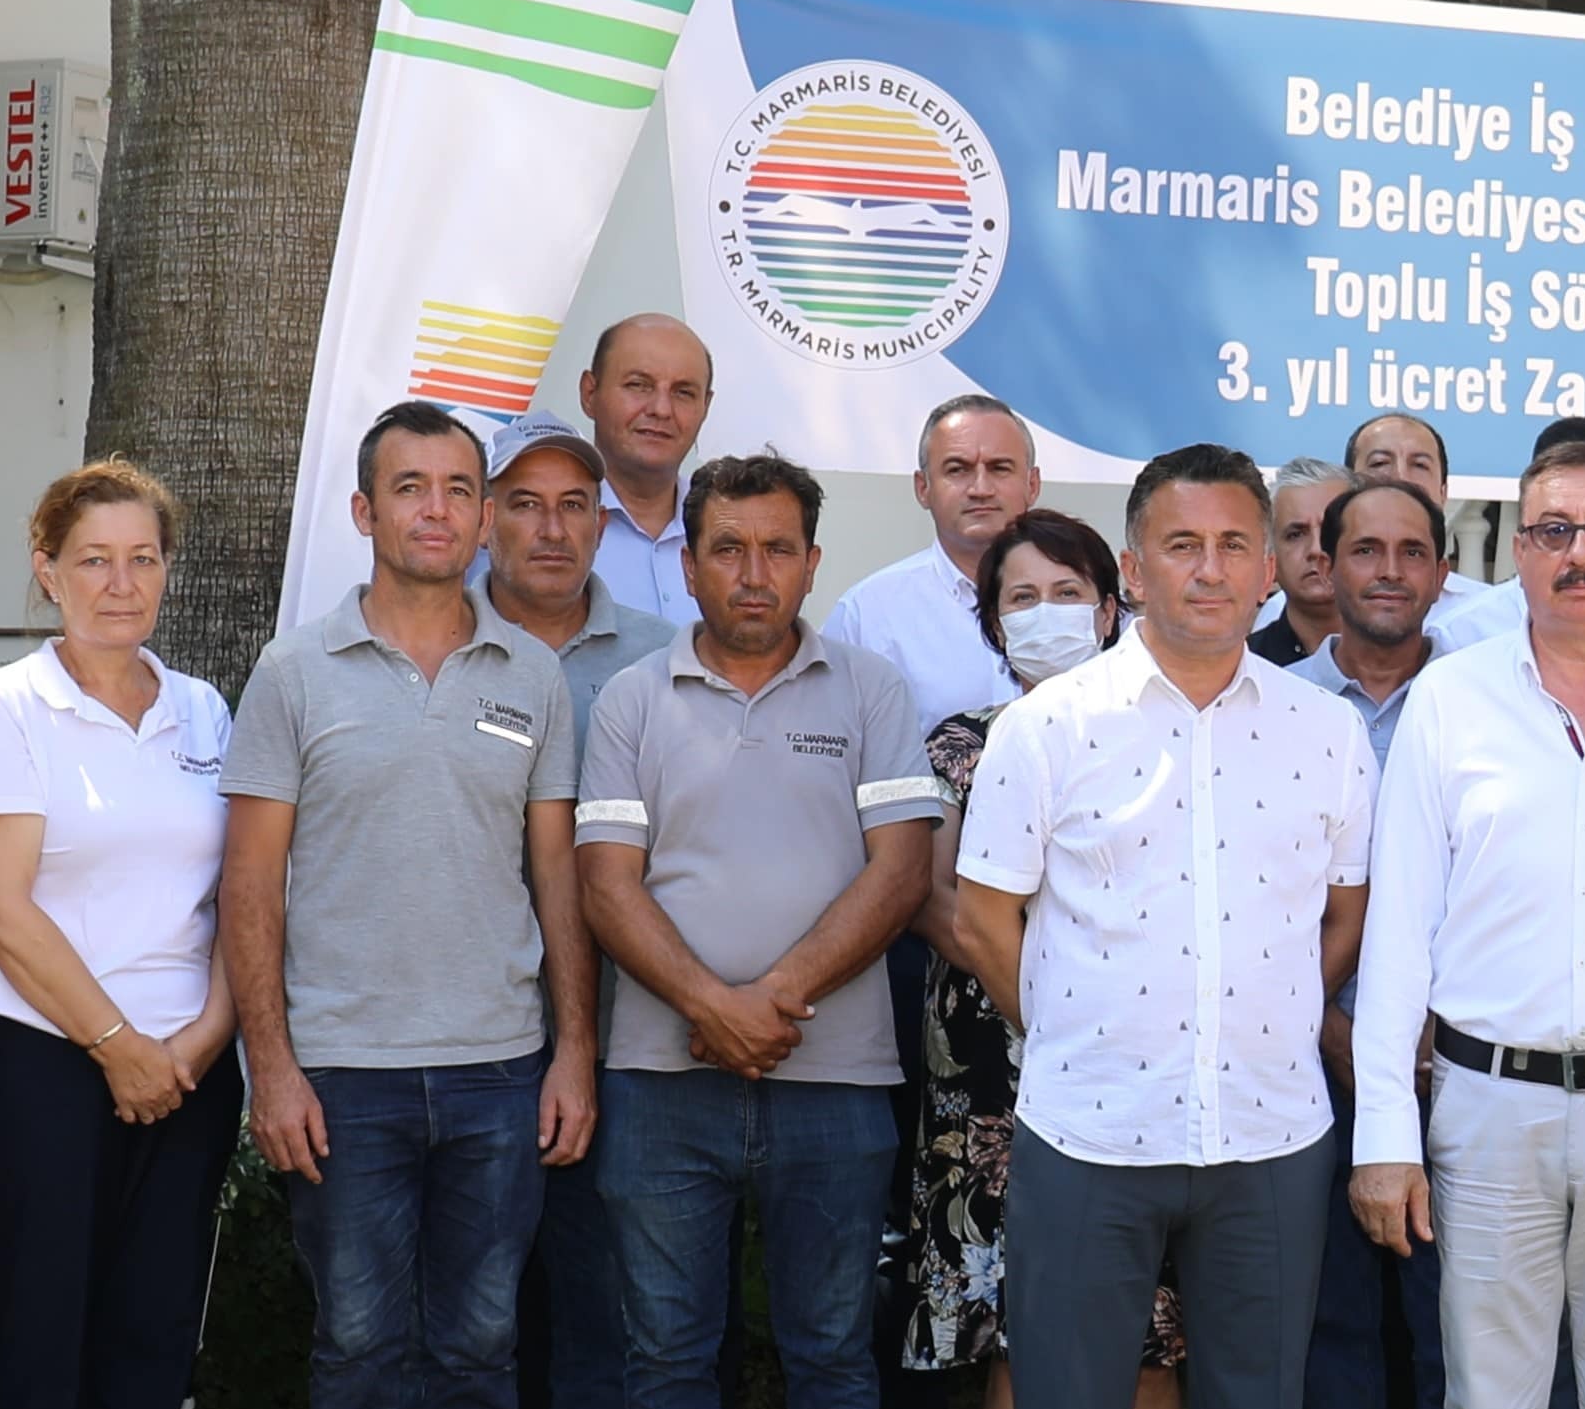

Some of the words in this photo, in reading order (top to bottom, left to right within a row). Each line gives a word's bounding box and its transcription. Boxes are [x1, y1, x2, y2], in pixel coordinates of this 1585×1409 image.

[5, 78, 35, 227] VESTEL
[725, 139, 756, 174] T.C.
[750, 70, 871, 133] MARMARİS
[879, 78, 991, 181] BELEDİYESİ
[1285, 75, 1511, 161] Belediye
[1529, 81, 1574, 172] İş
[1057, 149, 1319, 227] Marmaris
[721, 229, 744, 277] T.R.
[740, 280, 855, 360] MARMARİS
[863, 246, 994, 360] MUNICIPALITY
[1306, 256, 1447, 333] Toplu
[1468, 252, 1512, 343] İş
[1217, 341, 1267, 401] 3.
[1286, 347, 1349, 417] yıl
[1368, 349, 1507, 414] ücret
